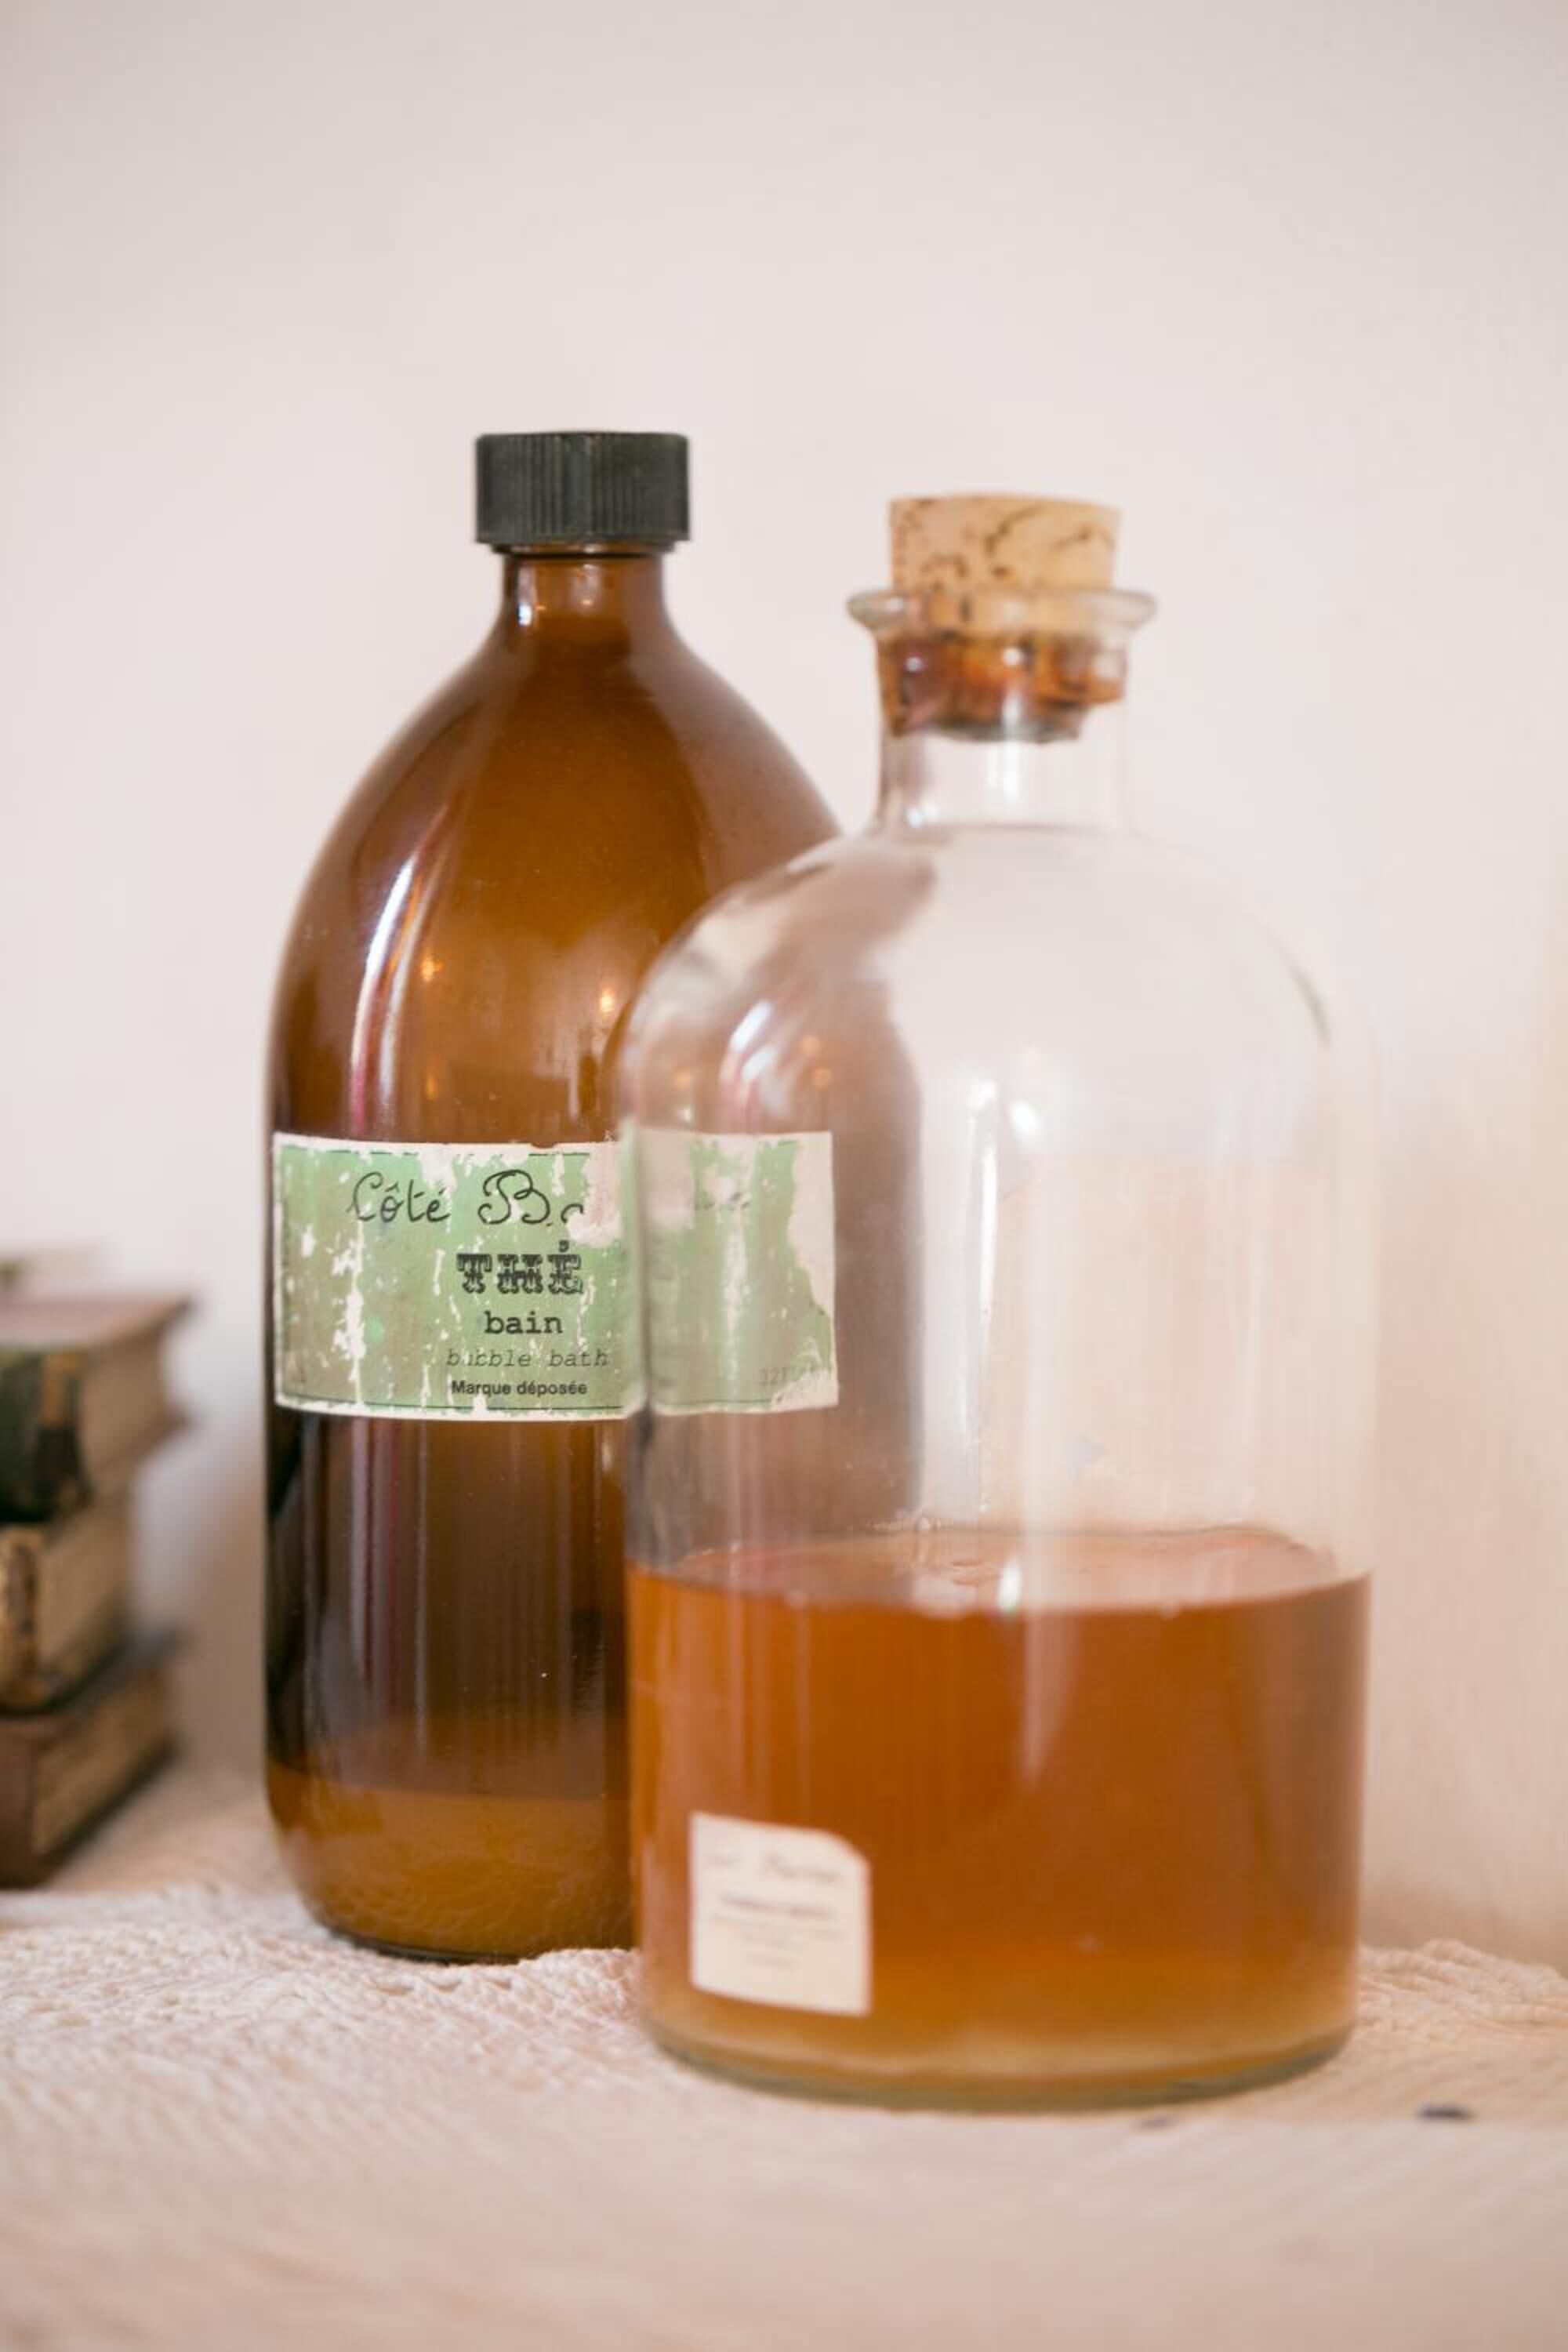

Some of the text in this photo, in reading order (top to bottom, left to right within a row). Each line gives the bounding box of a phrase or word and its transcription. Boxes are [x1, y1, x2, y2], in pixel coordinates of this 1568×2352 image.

[347, 1171, 452, 1223] Côté
[456, 1240, 583, 1294] THÉ
[484, 1310, 563, 1334] bain
[548, 1348, 609, 1367] bath
[451, 1379, 587, 1398] Marque déposée
